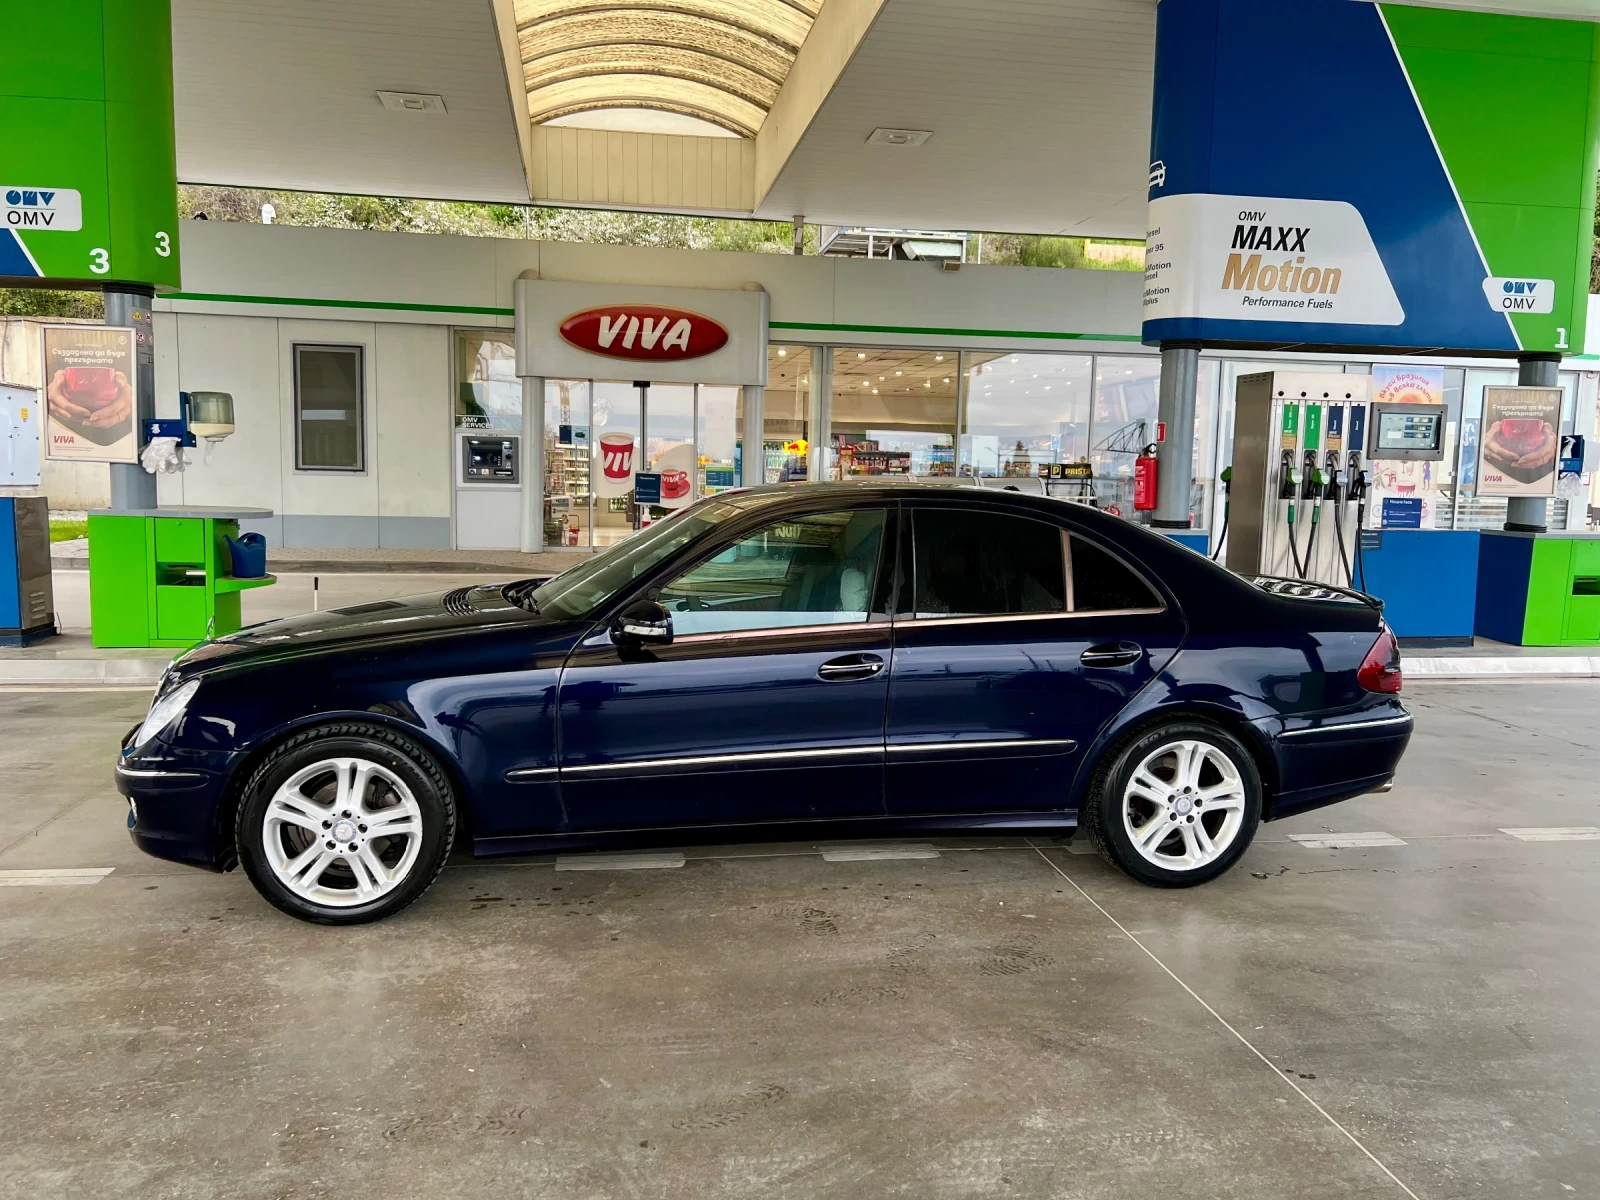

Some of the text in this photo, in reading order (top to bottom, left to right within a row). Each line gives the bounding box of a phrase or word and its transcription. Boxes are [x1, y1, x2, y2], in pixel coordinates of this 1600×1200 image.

[7, 210, 55, 226] OMV
[1238, 211, 1266, 222] OMV
[154, 231, 171, 257] 3
[1231, 225, 1311, 252] MAXX
[1154, 243, 1164, 252] 95
[89, 248, 110, 274] 3
[1221, 253, 1342, 294] Motion
[1242, 296, 1334, 309] Performance Fuels
[1502, 297, 1536, 310] OMV
[597, 313, 692, 352] VIVA
[1554, 328, 1569, 349] 1
[106, 349, 126, 358] бъде
[53, 435, 75, 444] VIVA
[661, 475, 679, 483] VIVA
